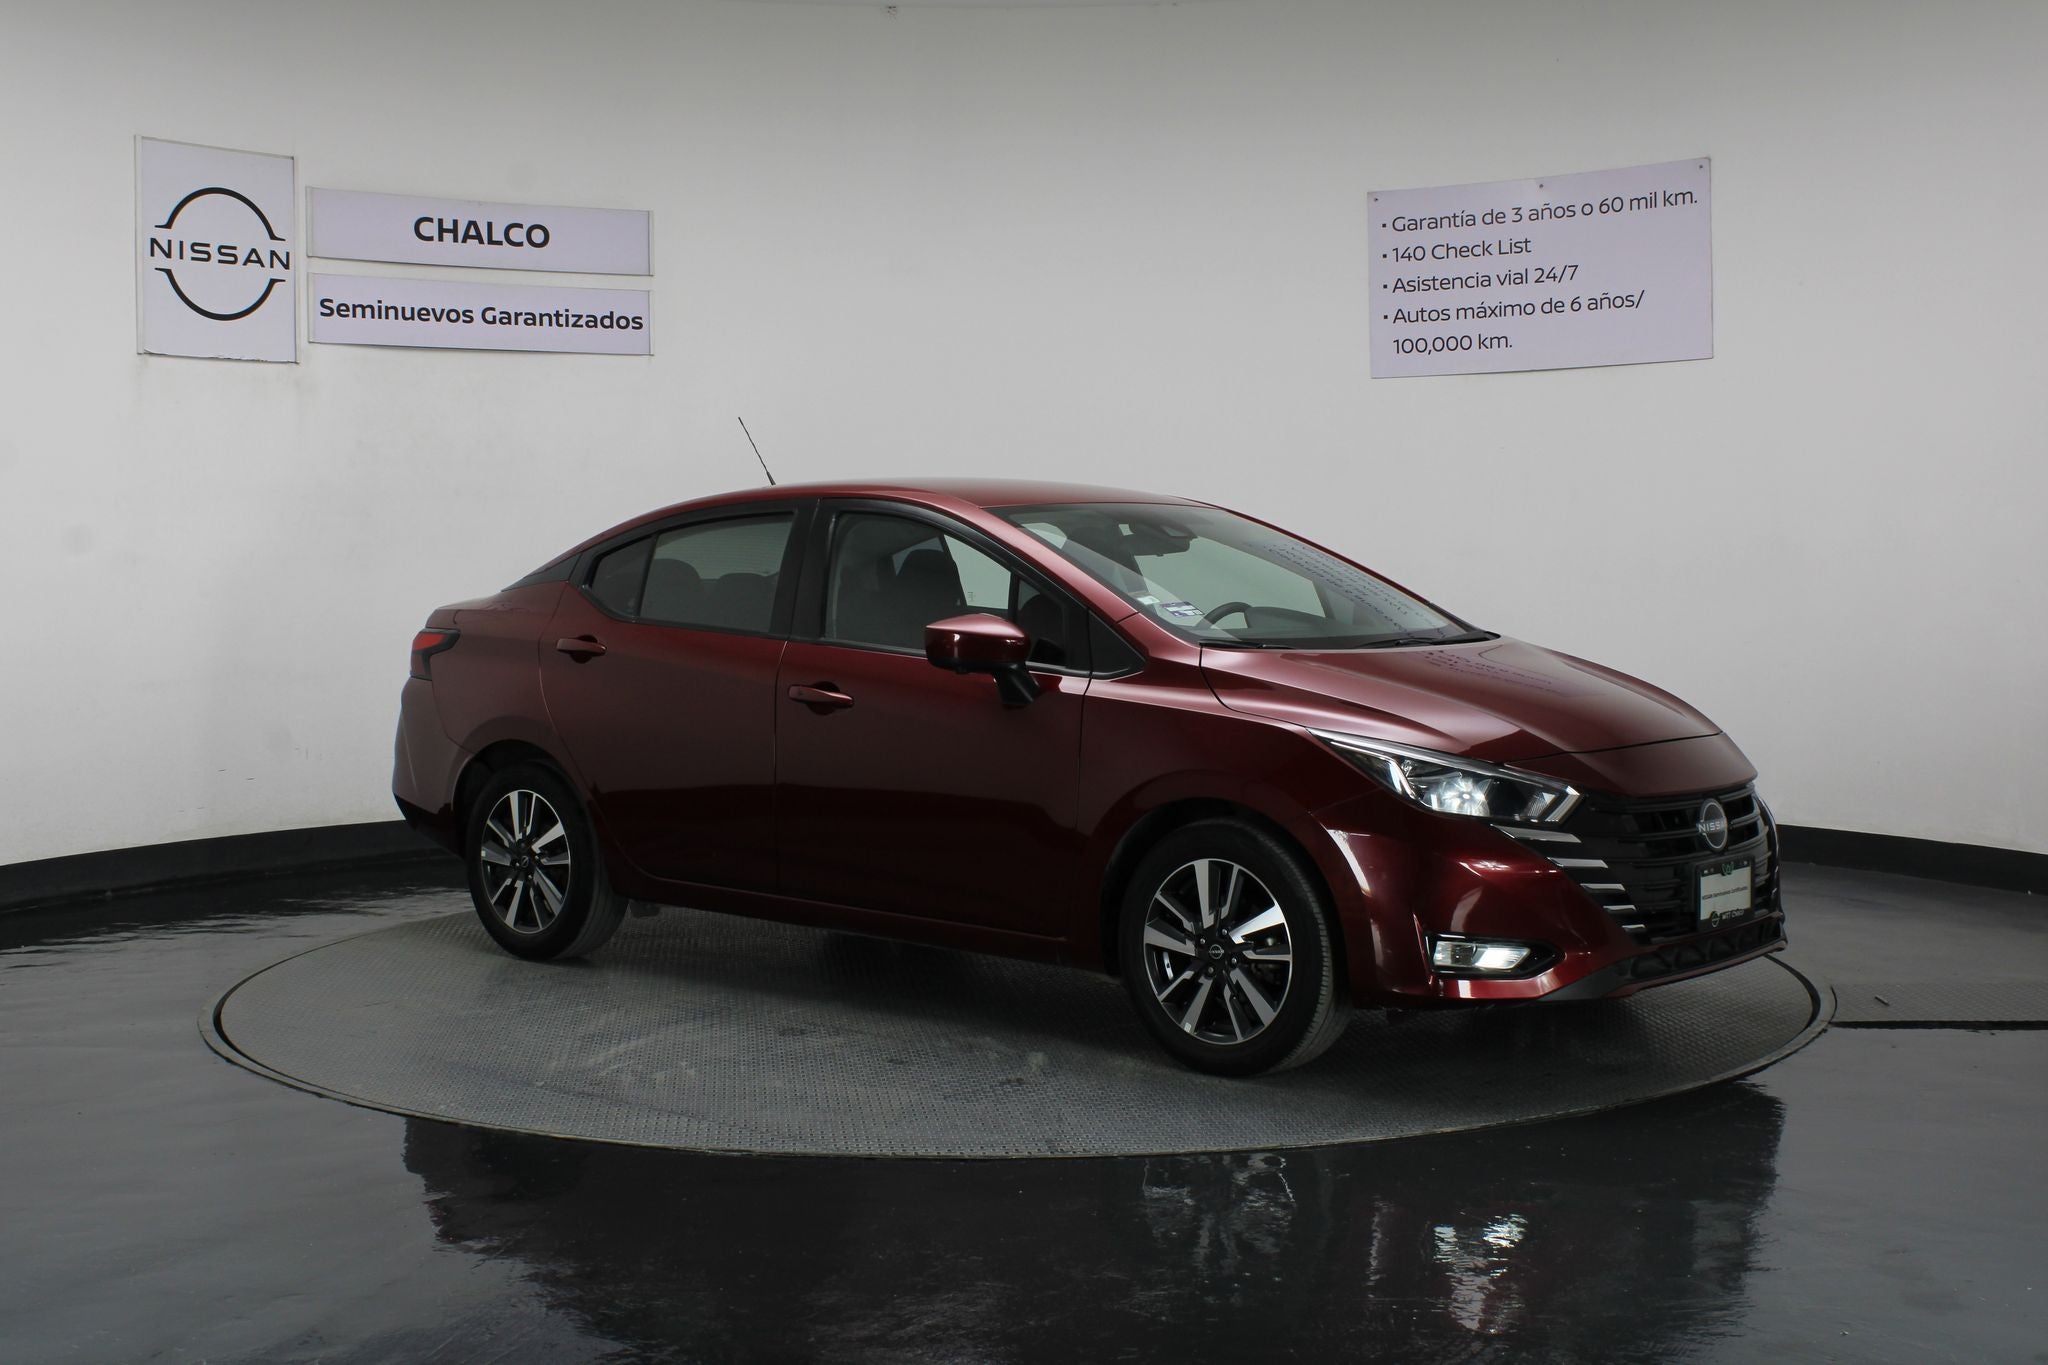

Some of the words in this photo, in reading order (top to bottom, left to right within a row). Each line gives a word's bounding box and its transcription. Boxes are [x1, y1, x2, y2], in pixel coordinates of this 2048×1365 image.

[1391, 209, 1477, 233] Garantía
[1481, 208, 1507, 226] de
[1511, 206, 1523, 223] 3
[1528, 202, 1577, 222] años
[1580, 202, 1594, 217] o
[1598, 196, 1624, 215] 60
[1629, 191, 1658, 212] mil
[1663, 189, 1698, 208] km.
[413, 216, 550, 249] CHALCO
[150, 237, 290, 271] NISSAN
[1391, 245, 1426, 263] 140
[1431, 239, 1494, 260] Check
[1498, 237, 1532, 256] List
[1391, 271, 1492, 294] Asistencia
[1495, 267, 1529, 287] vial
[1534, 264, 1579, 284] 24/7
[319, 298, 475, 324] Seminuevos
[481, 306, 644, 331] Garantizados
[1392, 306, 1451, 325] Autos
[1456, 300, 1536, 321] máximo
[1540, 297, 1565, 315] de
[1570, 295, 1582, 313] 6
[1587, 289, 1645, 311] años/
[1392, 334, 1473, 356] 100,000
[1478, 333, 1513, 350] km.
